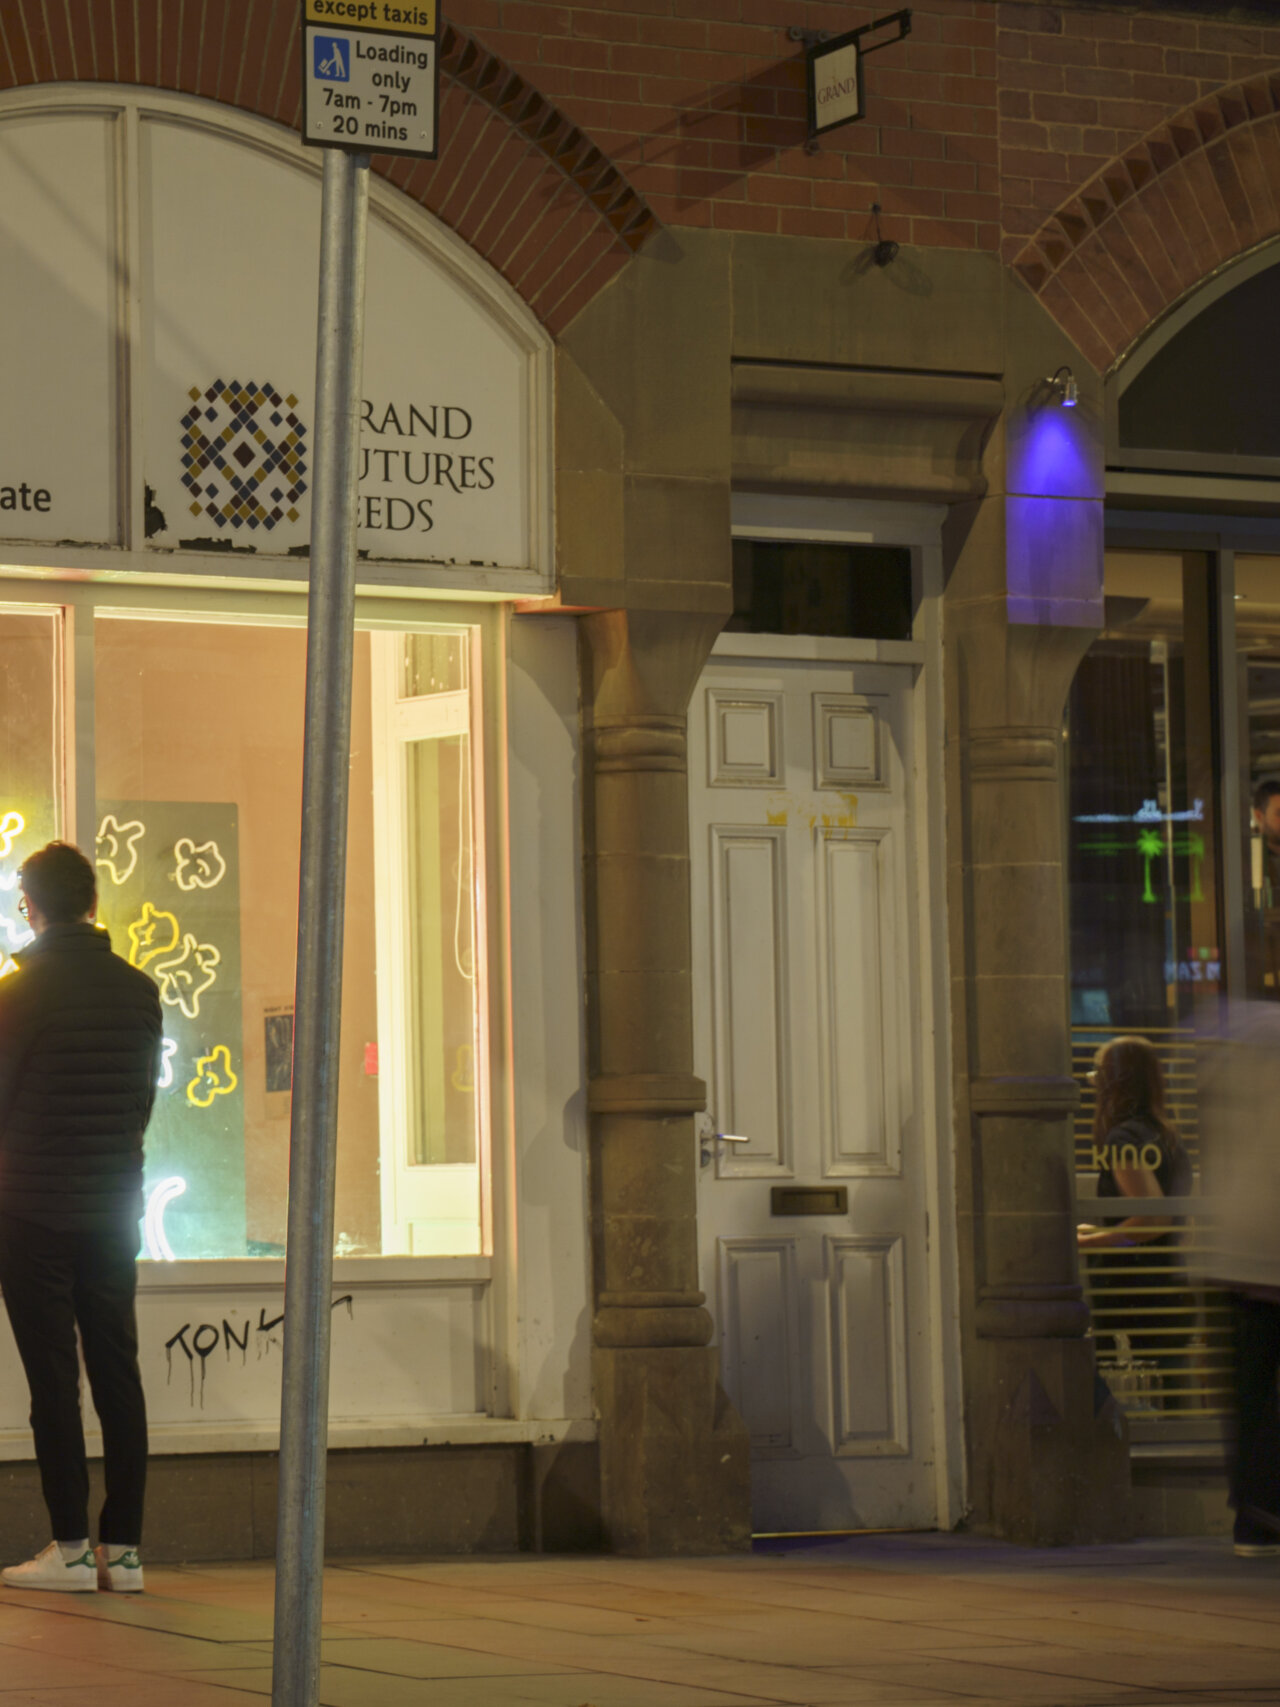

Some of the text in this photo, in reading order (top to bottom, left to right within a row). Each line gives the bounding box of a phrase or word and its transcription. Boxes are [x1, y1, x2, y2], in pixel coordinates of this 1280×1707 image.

[314, 0, 428, 26] except taxis
[356, 40, 428, 69] Loading
[372, 71, 411, 93] only
[817, 77, 855, 105] GRAND
[323, 88, 360, 110] 7am
[379, 95, 417, 117] 7pm
[333, 115, 408, 141] 20 mins
[357, 400, 472, 440] RAND
[357, 448, 495, 494] UTURES
